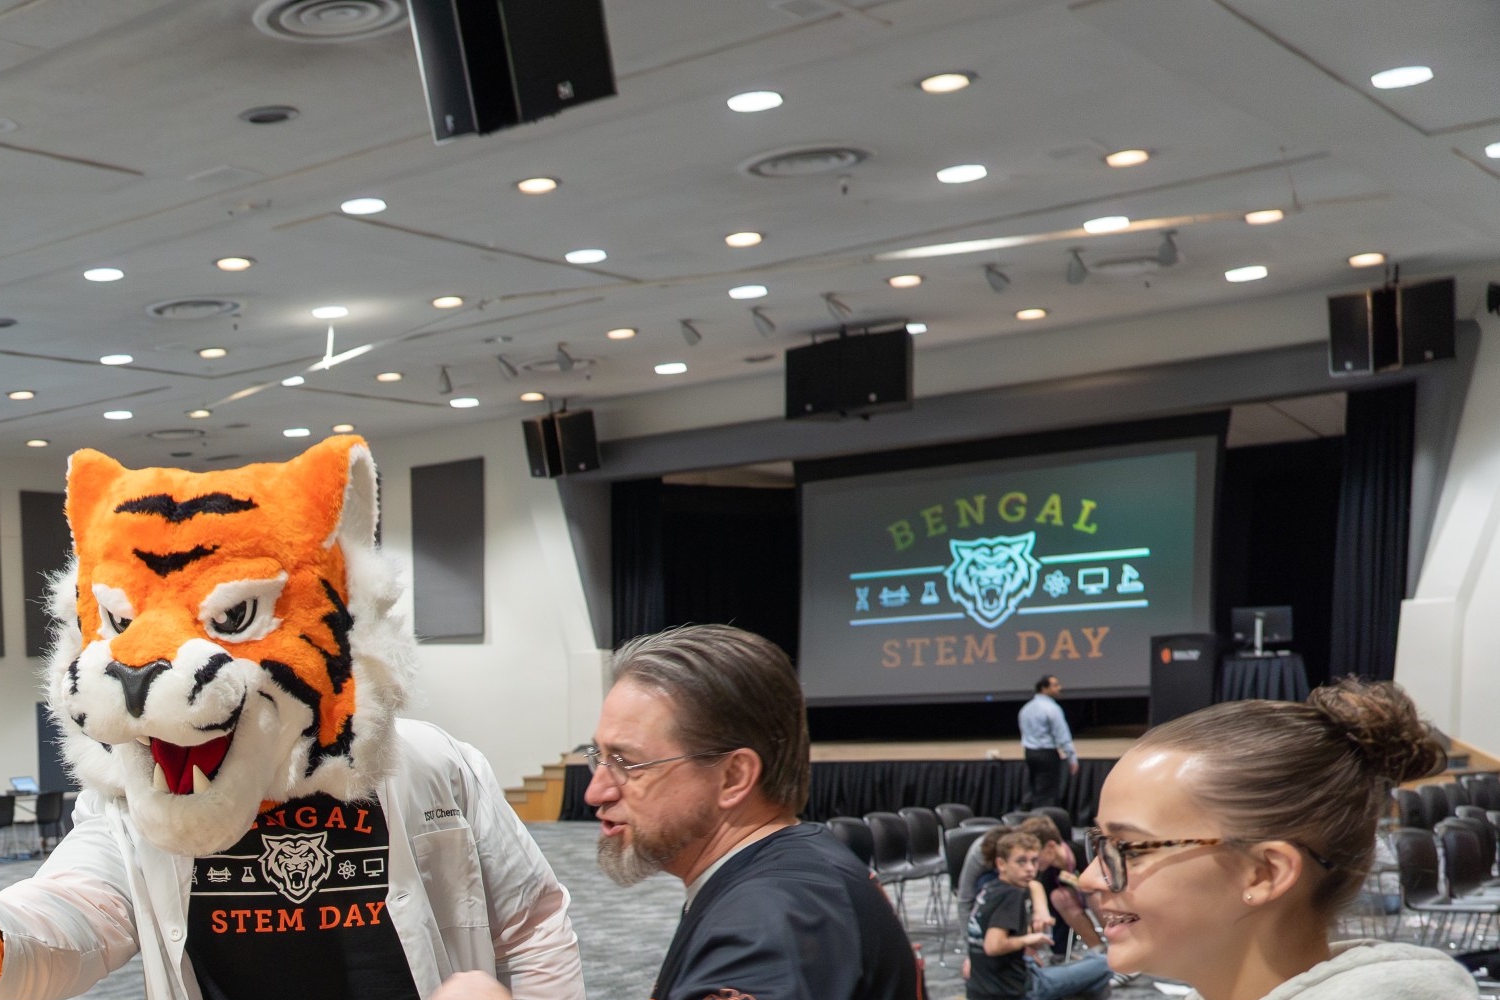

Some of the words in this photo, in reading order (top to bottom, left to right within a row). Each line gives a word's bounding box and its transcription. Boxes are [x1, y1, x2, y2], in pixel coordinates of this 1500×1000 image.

[887, 491, 1099, 552] BENGAL
[881, 634, 999, 668] STEM
[1016, 626, 1111, 662] DAY
[250, 806, 373, 835] NGAL
[211, 909, 306, 934] STEM
[319, 901, 386, 930] DAY
